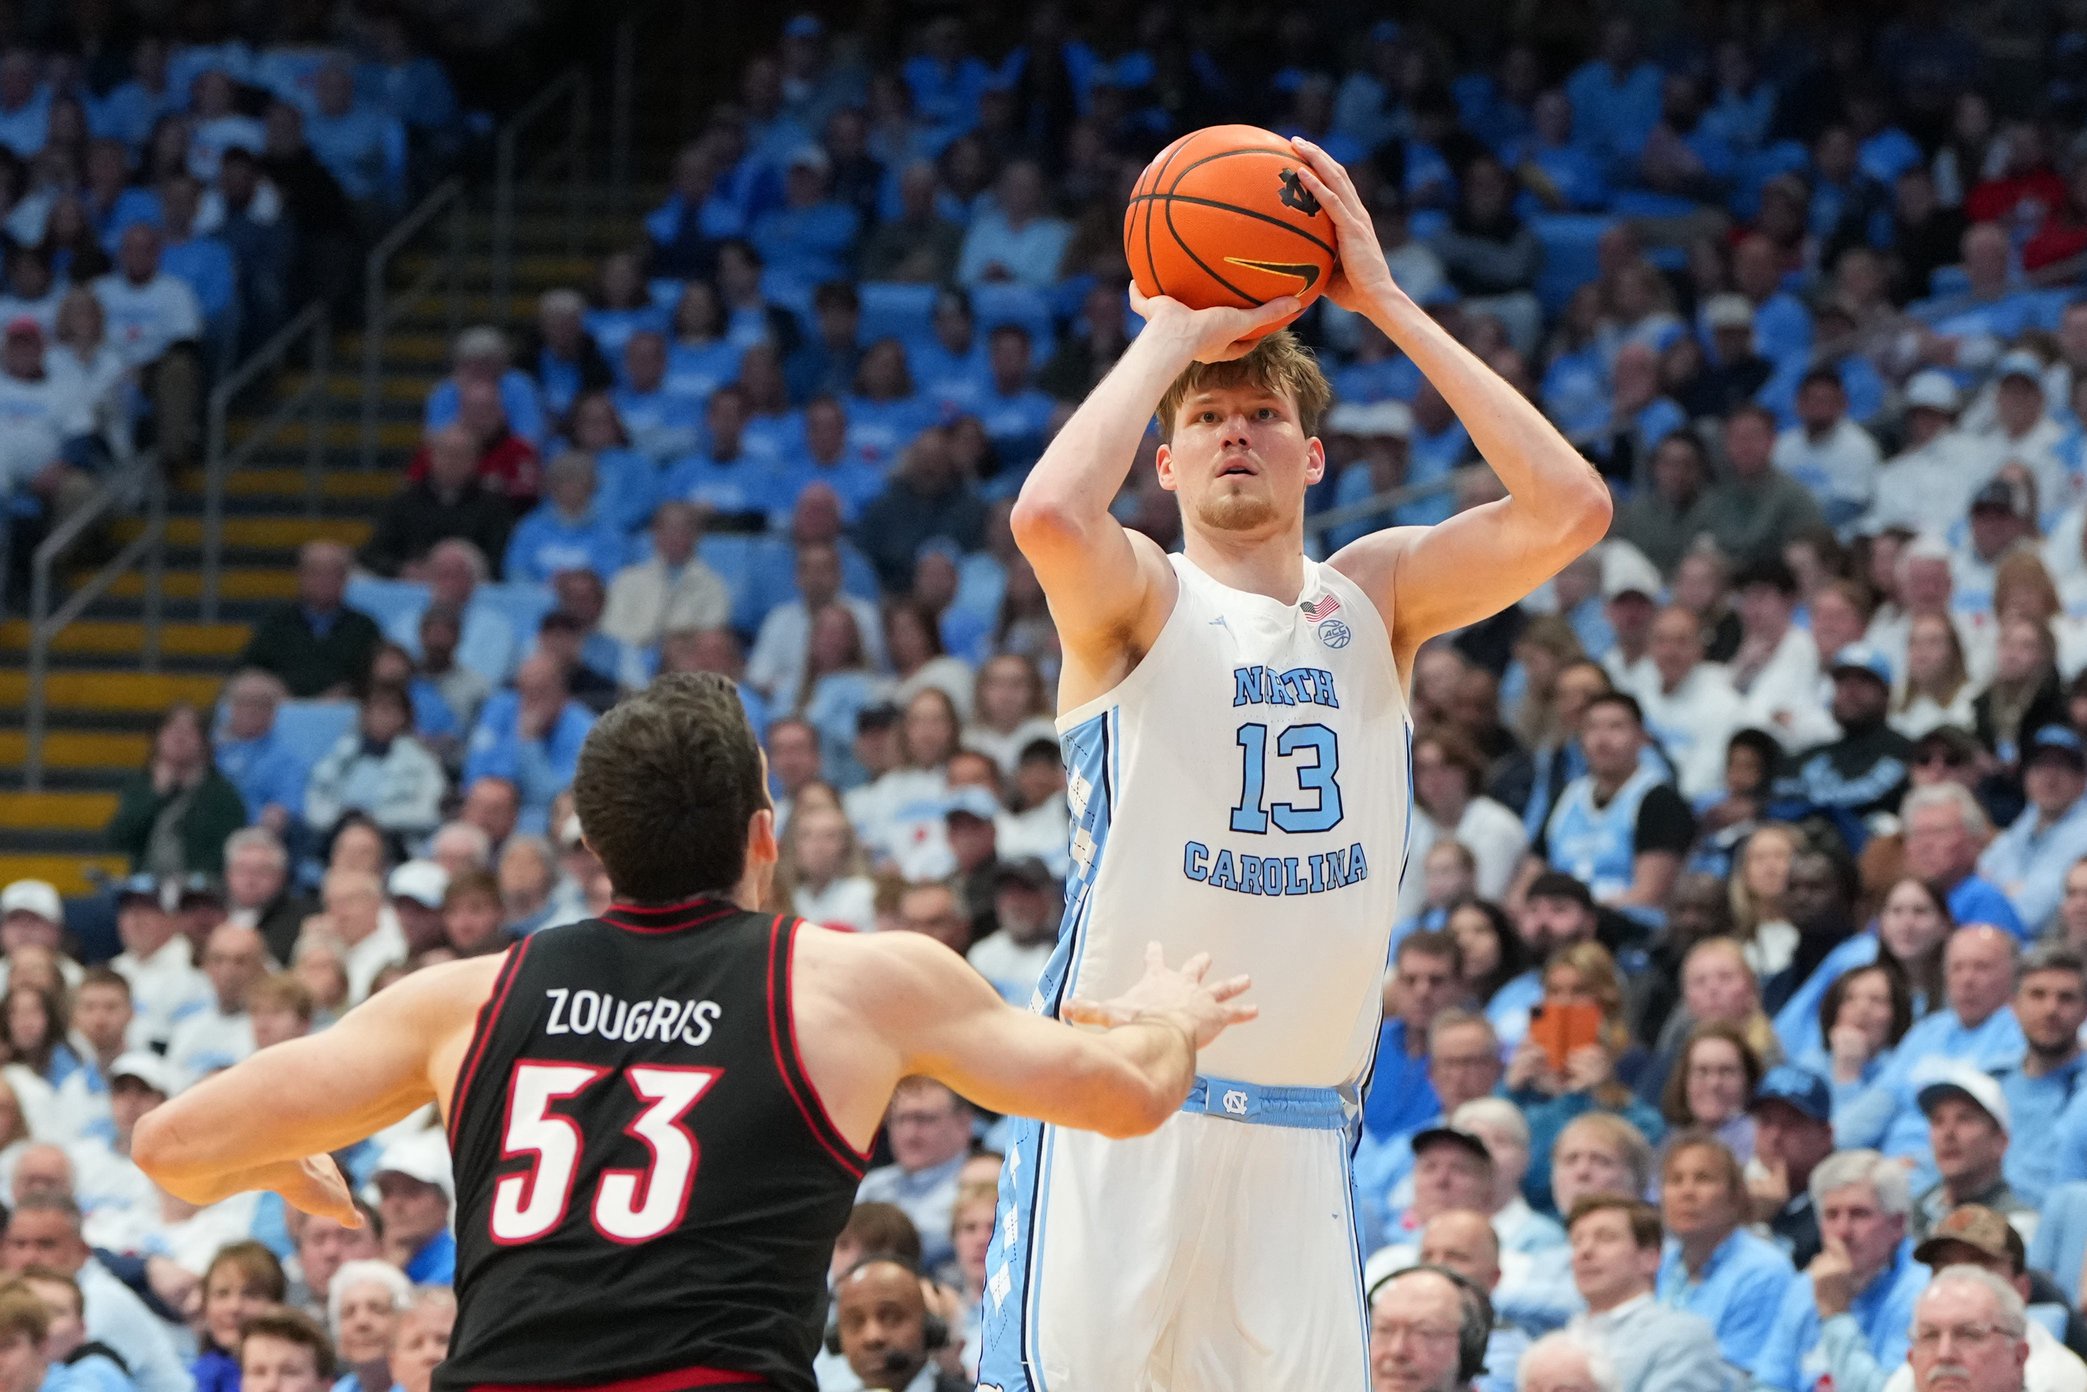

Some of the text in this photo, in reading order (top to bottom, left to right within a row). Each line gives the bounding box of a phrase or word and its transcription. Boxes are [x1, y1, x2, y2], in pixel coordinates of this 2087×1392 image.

[1233, 665, 1340, 709] NRTH
[1229, 722, 1344, 834] 13
[1183, 840, 1369, 896] CAROLINA
[546, 988, 722, 1047] ZOUGRIS
[489, 1058, 726, 1246] 53
